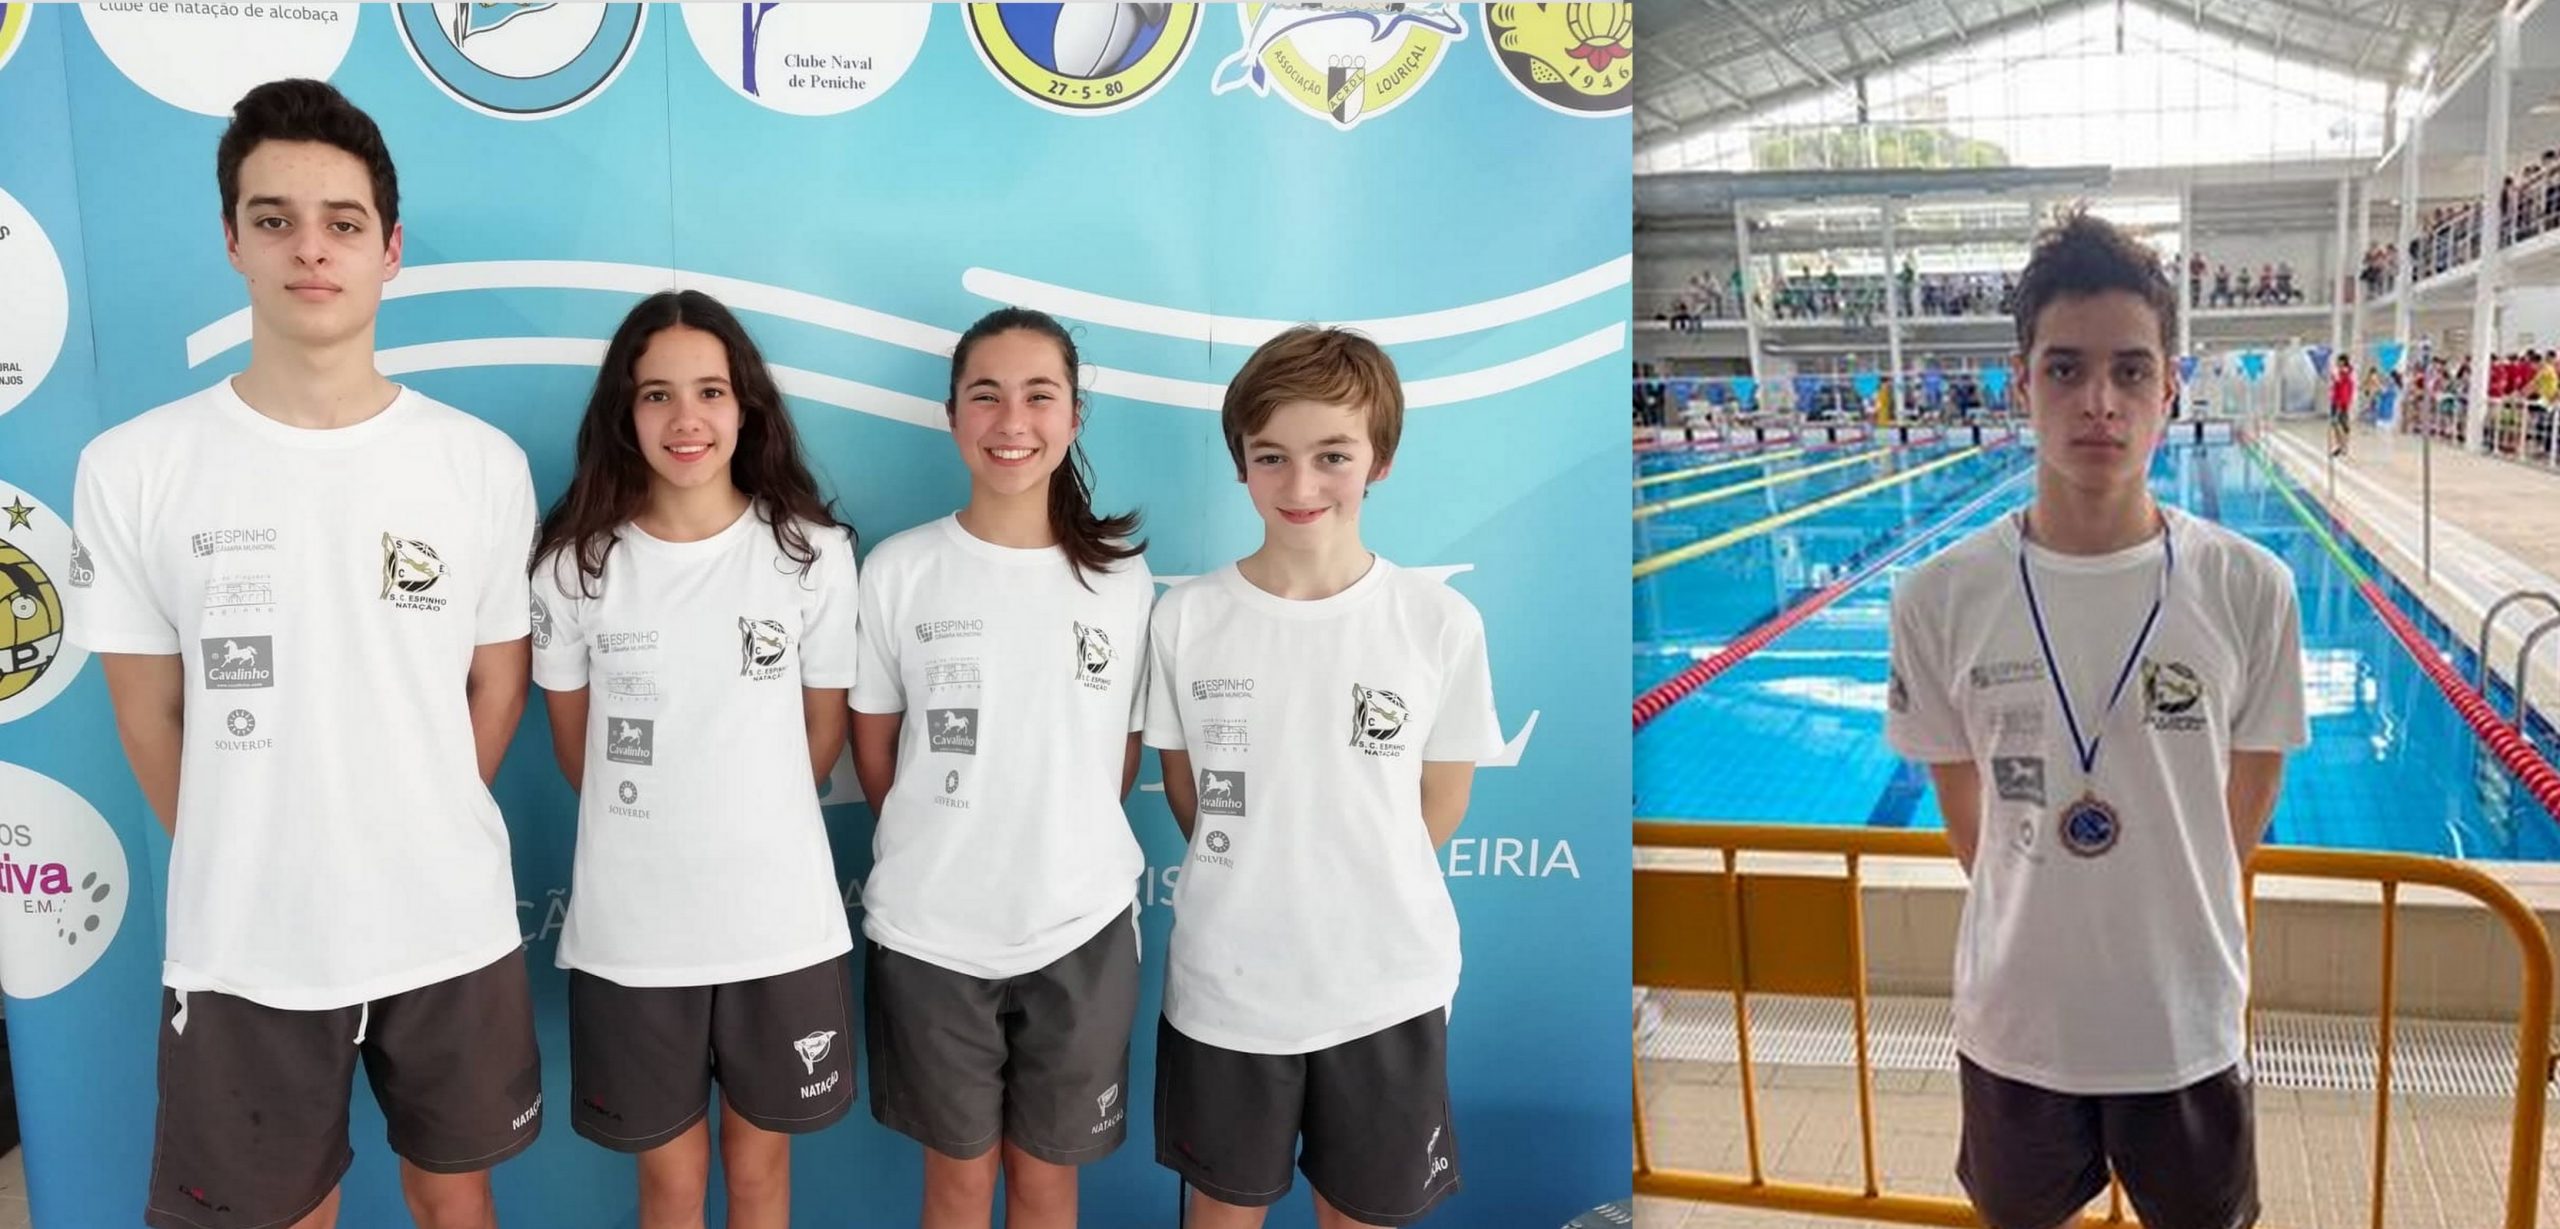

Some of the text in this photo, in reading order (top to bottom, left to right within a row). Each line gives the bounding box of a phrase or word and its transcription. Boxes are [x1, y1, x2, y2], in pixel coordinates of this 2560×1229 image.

[175, 3, 239, 18] natação
[244, 5, 264, 18] de
[269, 6, 339, 24] alcobaça
[784, 53, 872, 70] Clube Naval
[1274, 50, 1322, 96] ASSOCIAÇÃO
[1375, 45, 1428, 95] LOURIÇAL
[788, 74, 866, 90] de Peniche
[1048, 80, 1068, 96] 27
[1081, 86, 1092, 99] 5
[1105, 80, 1124, 97] 80
[215, 528, 277, 544] ESPINHO
[395, 602, 441, 612] NATAÇÃO
[408, 595, 447, 606] ESPINHO
[935, 618, 983, 633] ESPINHO
[609, 630, 659, 646] ESPINHO
[209, 667, 270, 681] Cavalinho
[1205, 678, 1255, 693] ESPINHO
[214, 738, 273, 752] SOLVERDE
[932, 734, 975, 748] Cavalinho
[608, 743, 651, 759] Cavalinho
[1364, 749, 1401, 758] NATAÇÃO
[608, 804, 651, 820] SOLVERDE
[800, 1070, 839, 1099] NATAÇÃO
